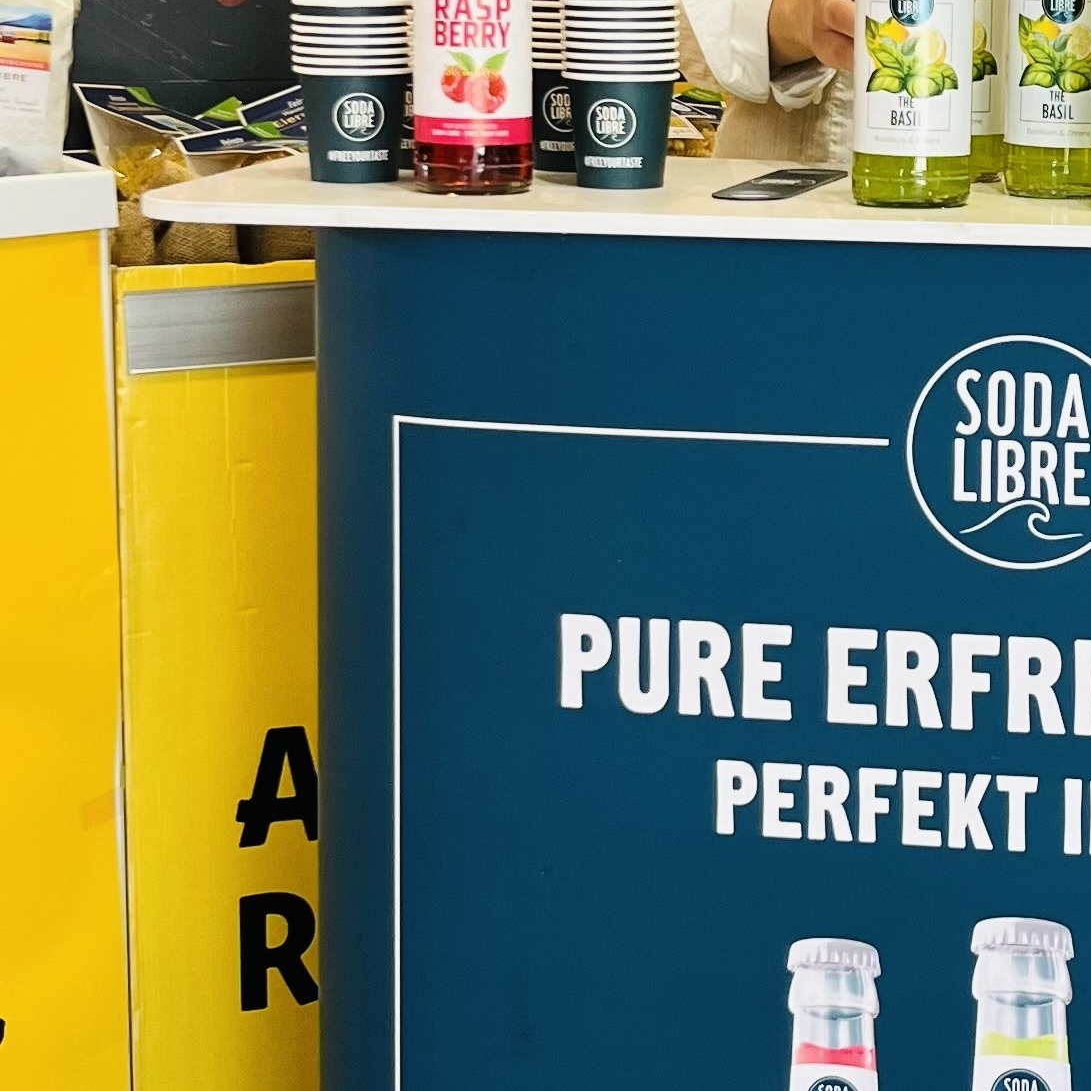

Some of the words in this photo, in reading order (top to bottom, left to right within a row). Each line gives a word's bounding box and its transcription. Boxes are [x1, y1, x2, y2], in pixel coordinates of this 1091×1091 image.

[897, 0, 923, 15] LIBR
[434, 20, 511, 48] BERRY
[551, 93, 571, 107] SOD
[898, 96, 915, 108] THE
[1049, 90, 1066, 103] THE
[343, 100, 375, 115] SODA
[551, 106, 573, 120] LIBR
[595, 106, 626, 121] SODA
[1042, 103, 1075, 120] BASIL
[342, 114, 375, 128] LIBRE
[595, 120, 627, 135] LIBRE
[954, 368, 1090, 439] SODA
[953, 438, 1091, 506] LIBRE
[559, 613, 792, 721] PURE
[715, 759, 1039, 852] PERFEKT
